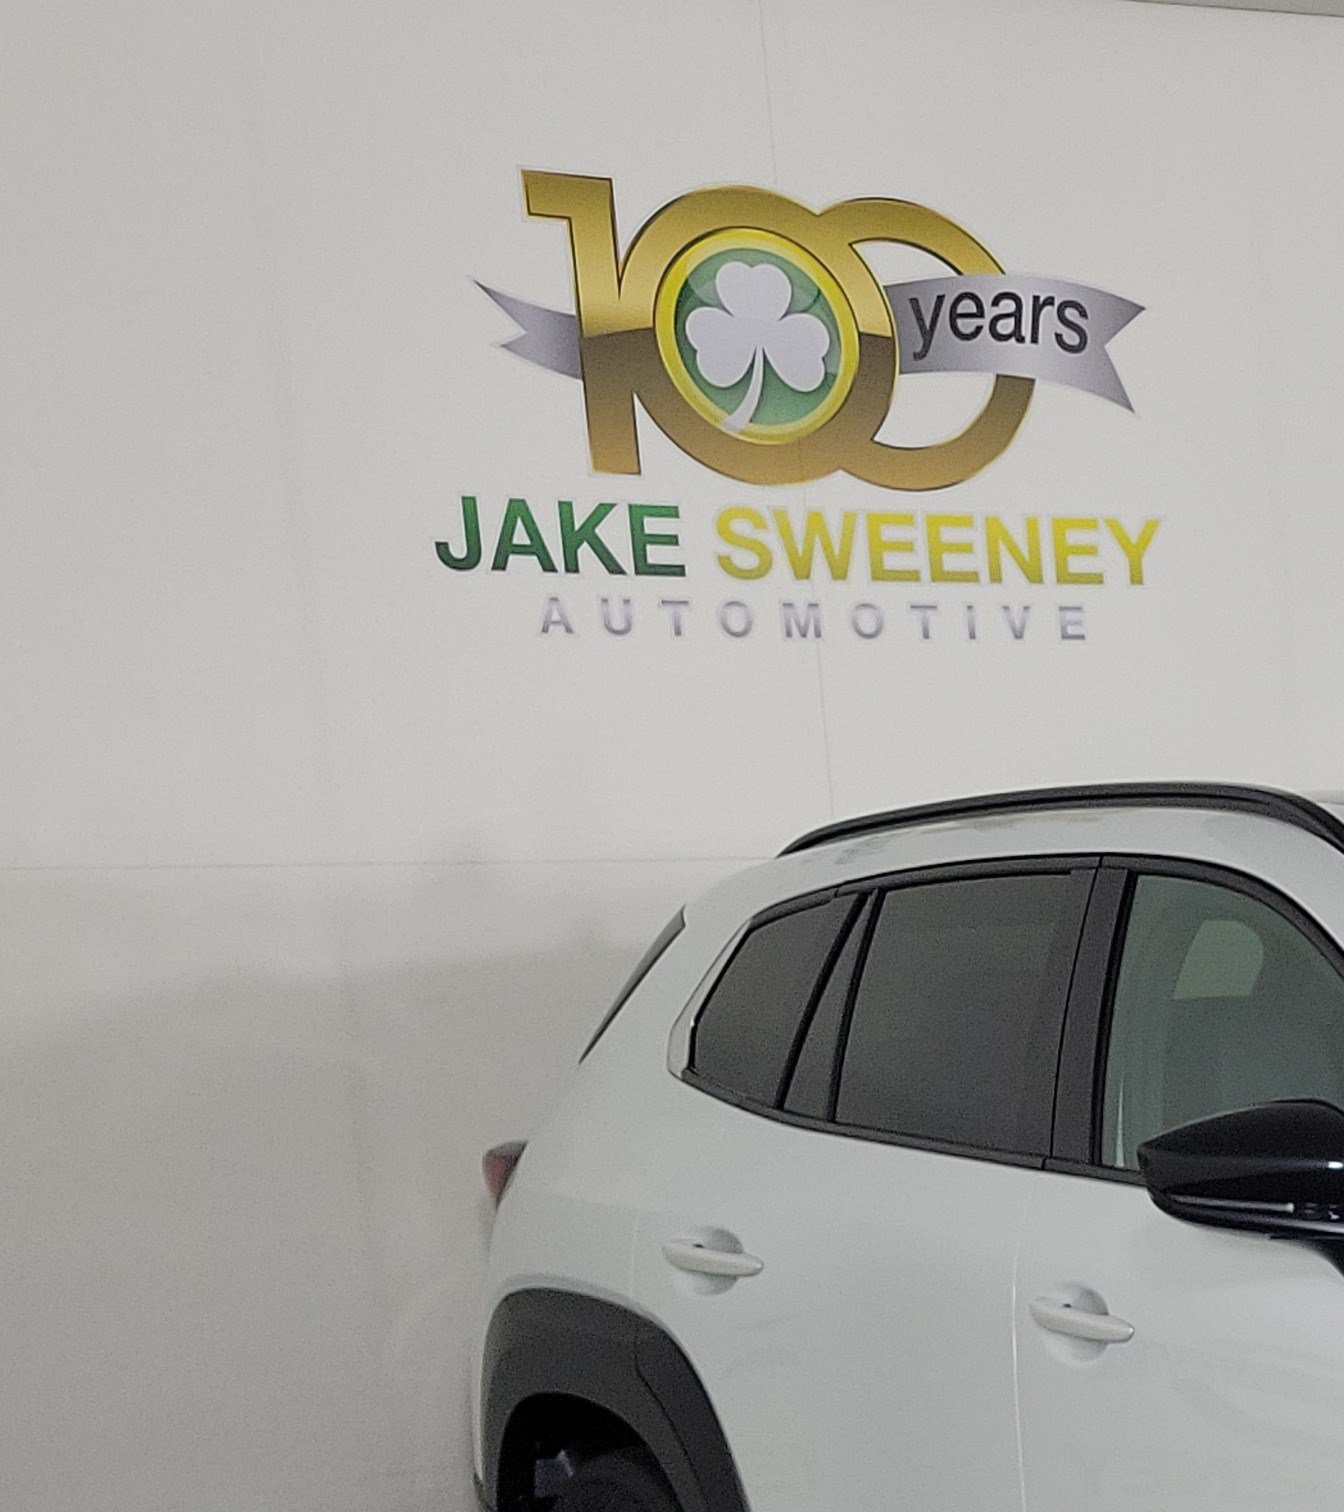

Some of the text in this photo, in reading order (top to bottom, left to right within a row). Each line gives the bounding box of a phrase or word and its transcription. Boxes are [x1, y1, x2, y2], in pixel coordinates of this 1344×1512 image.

[908, 289, 1090, 361] years
[434, 495, 1162, 586] JAKE SWEENEY
[539, 596, 1088, 642] AUTOMOTIVE
